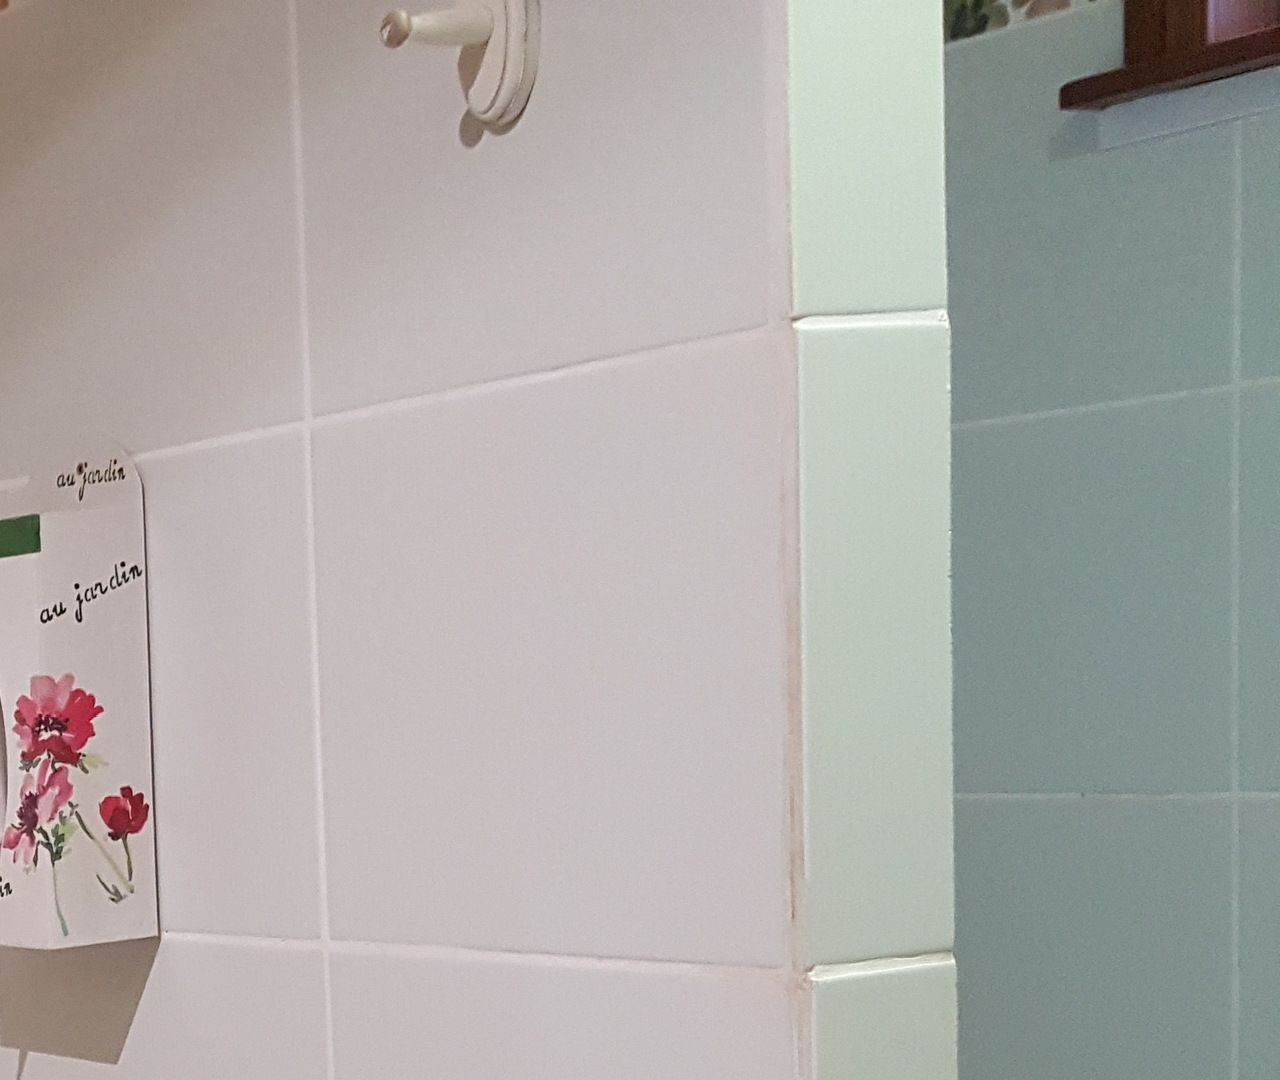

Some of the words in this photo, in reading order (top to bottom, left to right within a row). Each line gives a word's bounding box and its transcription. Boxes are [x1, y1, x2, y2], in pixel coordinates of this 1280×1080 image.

[56, 473, 76, 488] au
[78, 458, 126, 501] jardin
[40, 601, 67, 624] au
[74, 560, 143, 623] jardin
